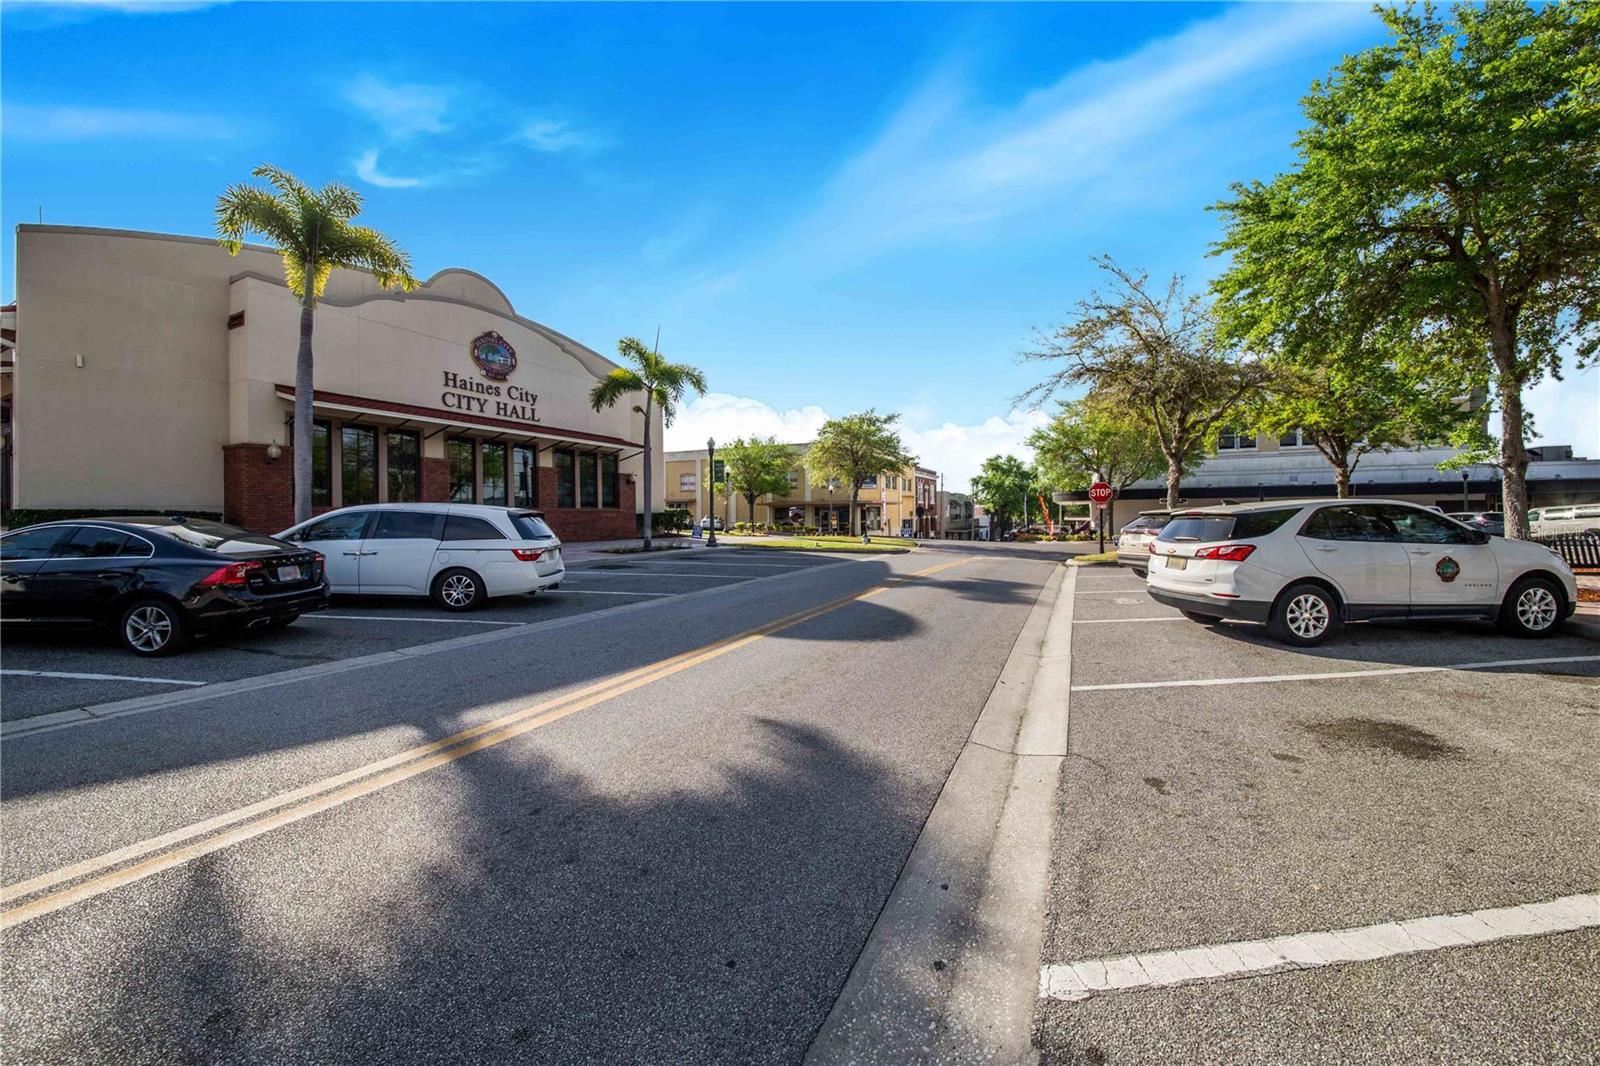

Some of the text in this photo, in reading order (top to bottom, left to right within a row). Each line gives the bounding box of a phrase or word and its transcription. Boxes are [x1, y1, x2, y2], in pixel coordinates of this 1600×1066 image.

[443, 371, 538, 406] Haines City
[442, 392, 541, 423] CITY HALL
[1091, 488, 1111, 497] STOP
